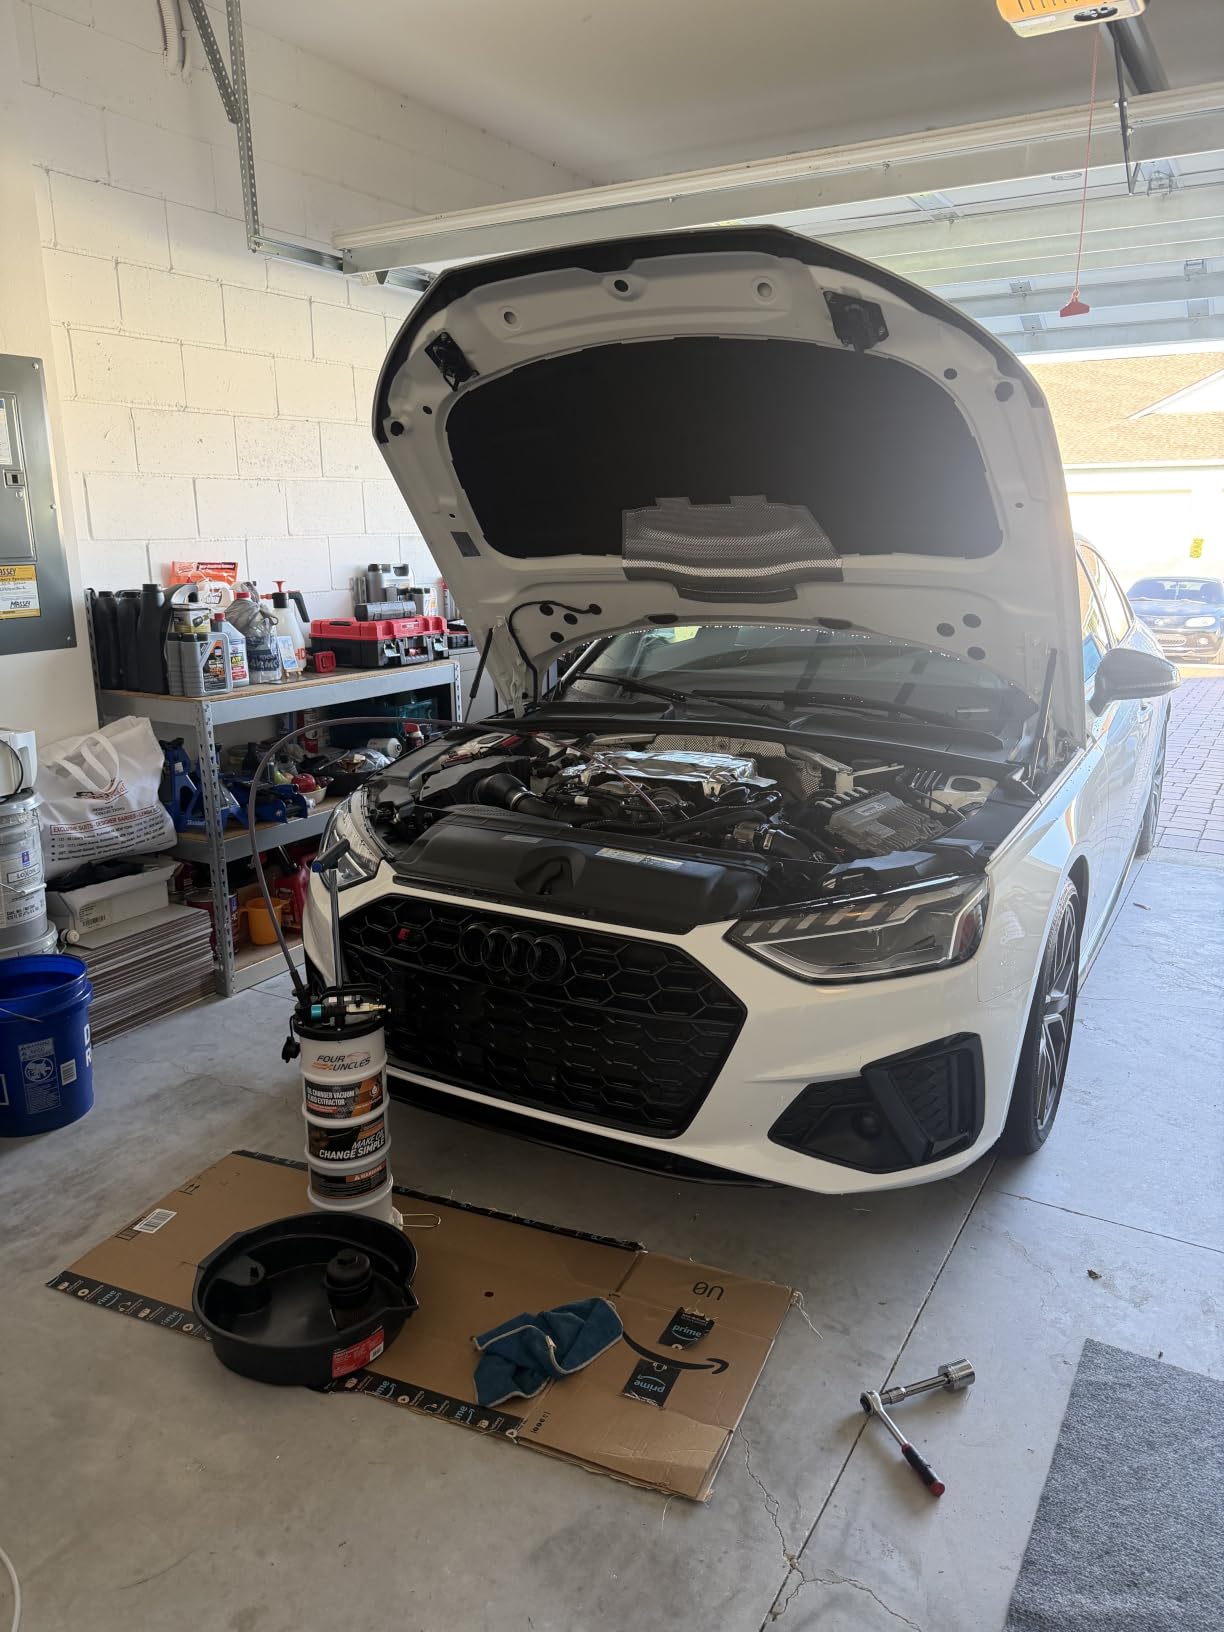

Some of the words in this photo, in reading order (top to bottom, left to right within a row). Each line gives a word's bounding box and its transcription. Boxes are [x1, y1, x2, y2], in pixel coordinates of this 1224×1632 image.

[316, 1054, 346, 1064] FOUR
[332, 1056, 372, 1072] UNCLES
[318, 1097, 346, 1106] EXTRACTOR
[333, 1090, 355, 1099] VACUUM
[319, 1149, 356, 1160] CHANGE
[357, 1138, 386, 1157] SIMPLE
[351, 1136, 375, 1150] MAKE
[671, 1324, 702, 1338] prime
[633, 1379, 666, 1393] prime
